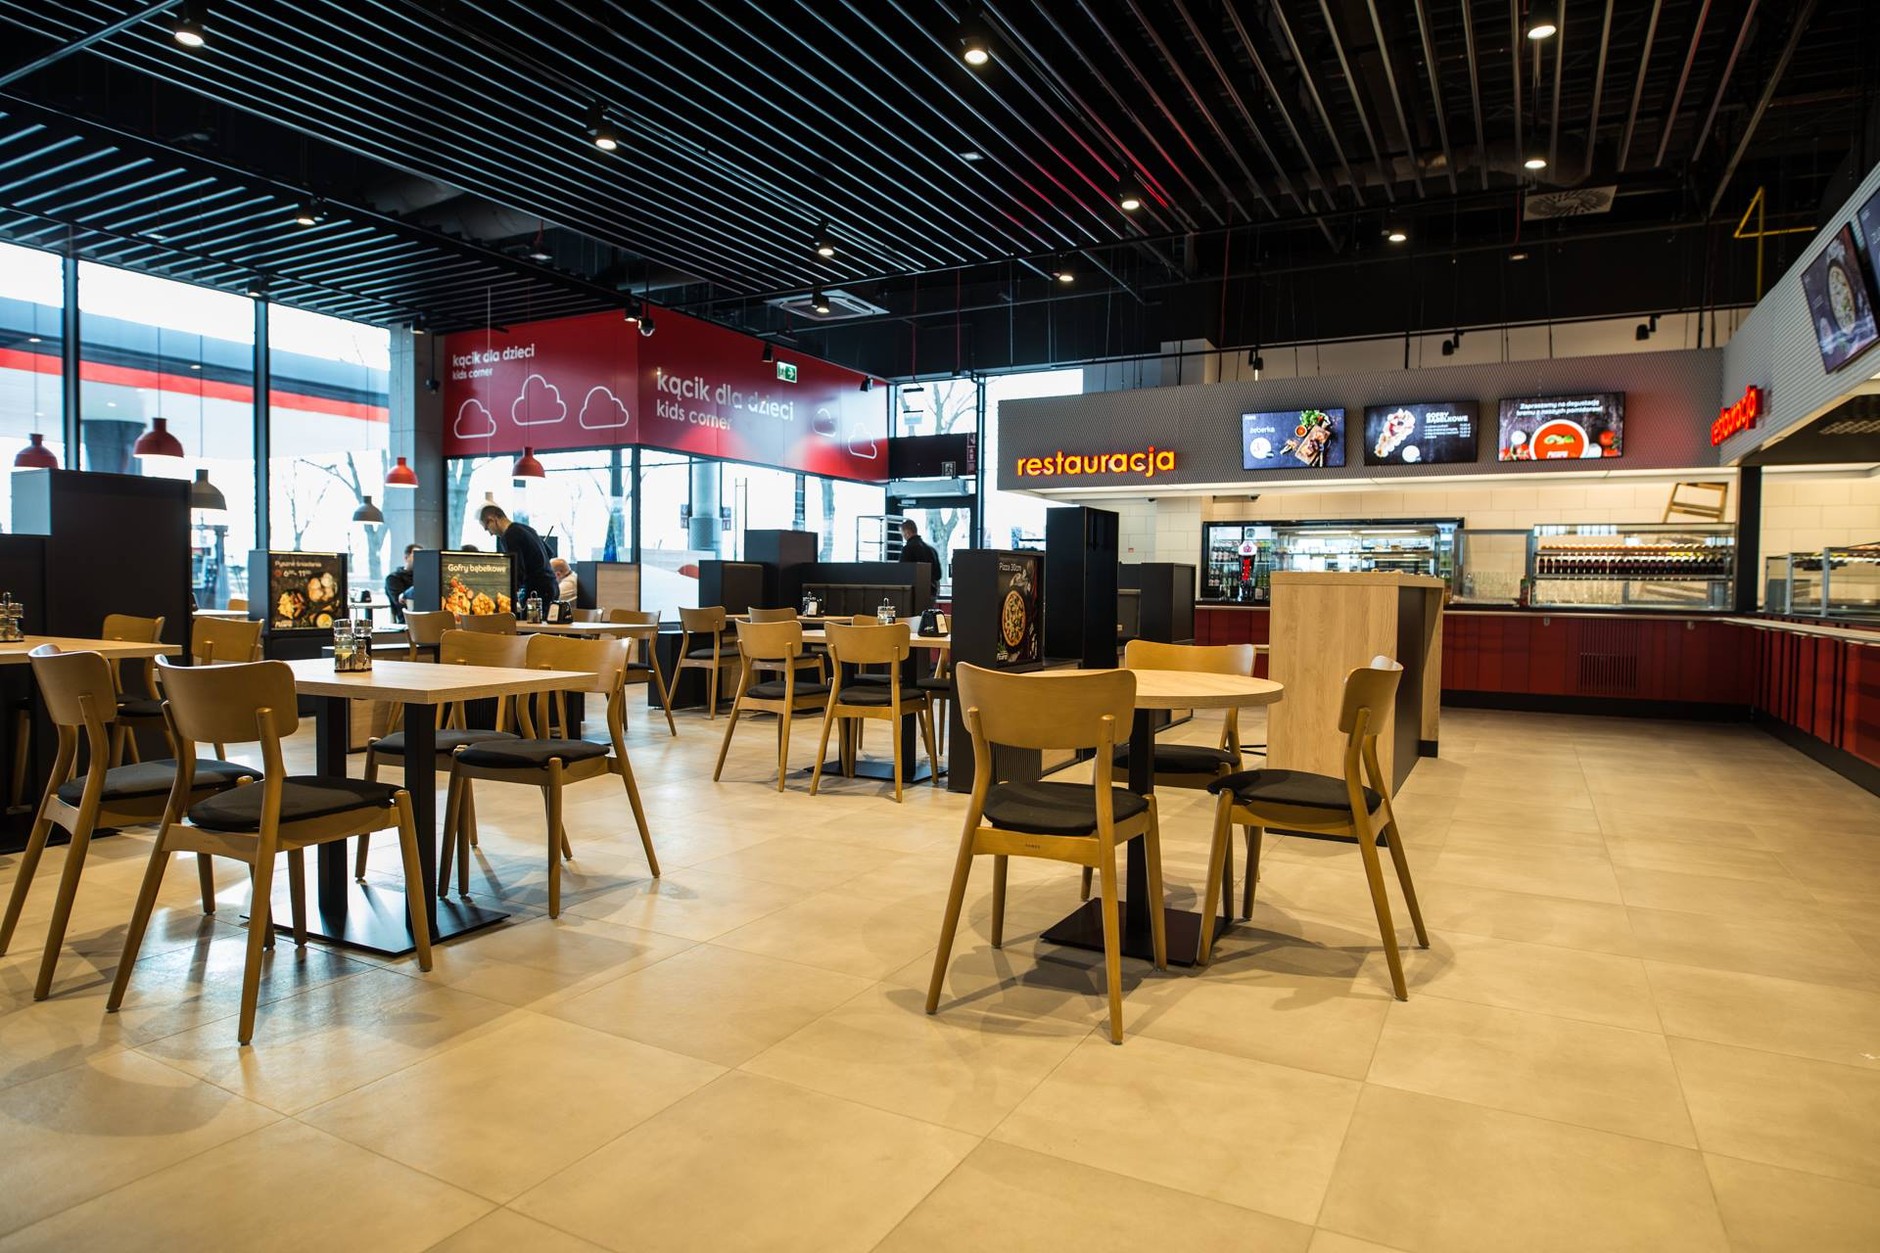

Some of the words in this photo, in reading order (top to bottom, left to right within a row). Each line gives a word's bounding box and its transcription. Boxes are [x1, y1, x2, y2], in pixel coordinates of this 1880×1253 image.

[452, 352, 481, 368] kącik
[483, 349, 500, 363] dla
[503, 343, 535, 360] dzieci
[452, 370, 467, 380] kids
[468, 367, 493, 378] corner
[657, 367, 710, 401] kącik
[715, 383, 742, 409] dla
[748, 391, 794, 421] dzieci
[657, 399, 685, 421] kids
[689, 411, 732, 430] corner
[1017, 445, 1175, 478] restauracja
[447, 563, 468, 573] Gofry
